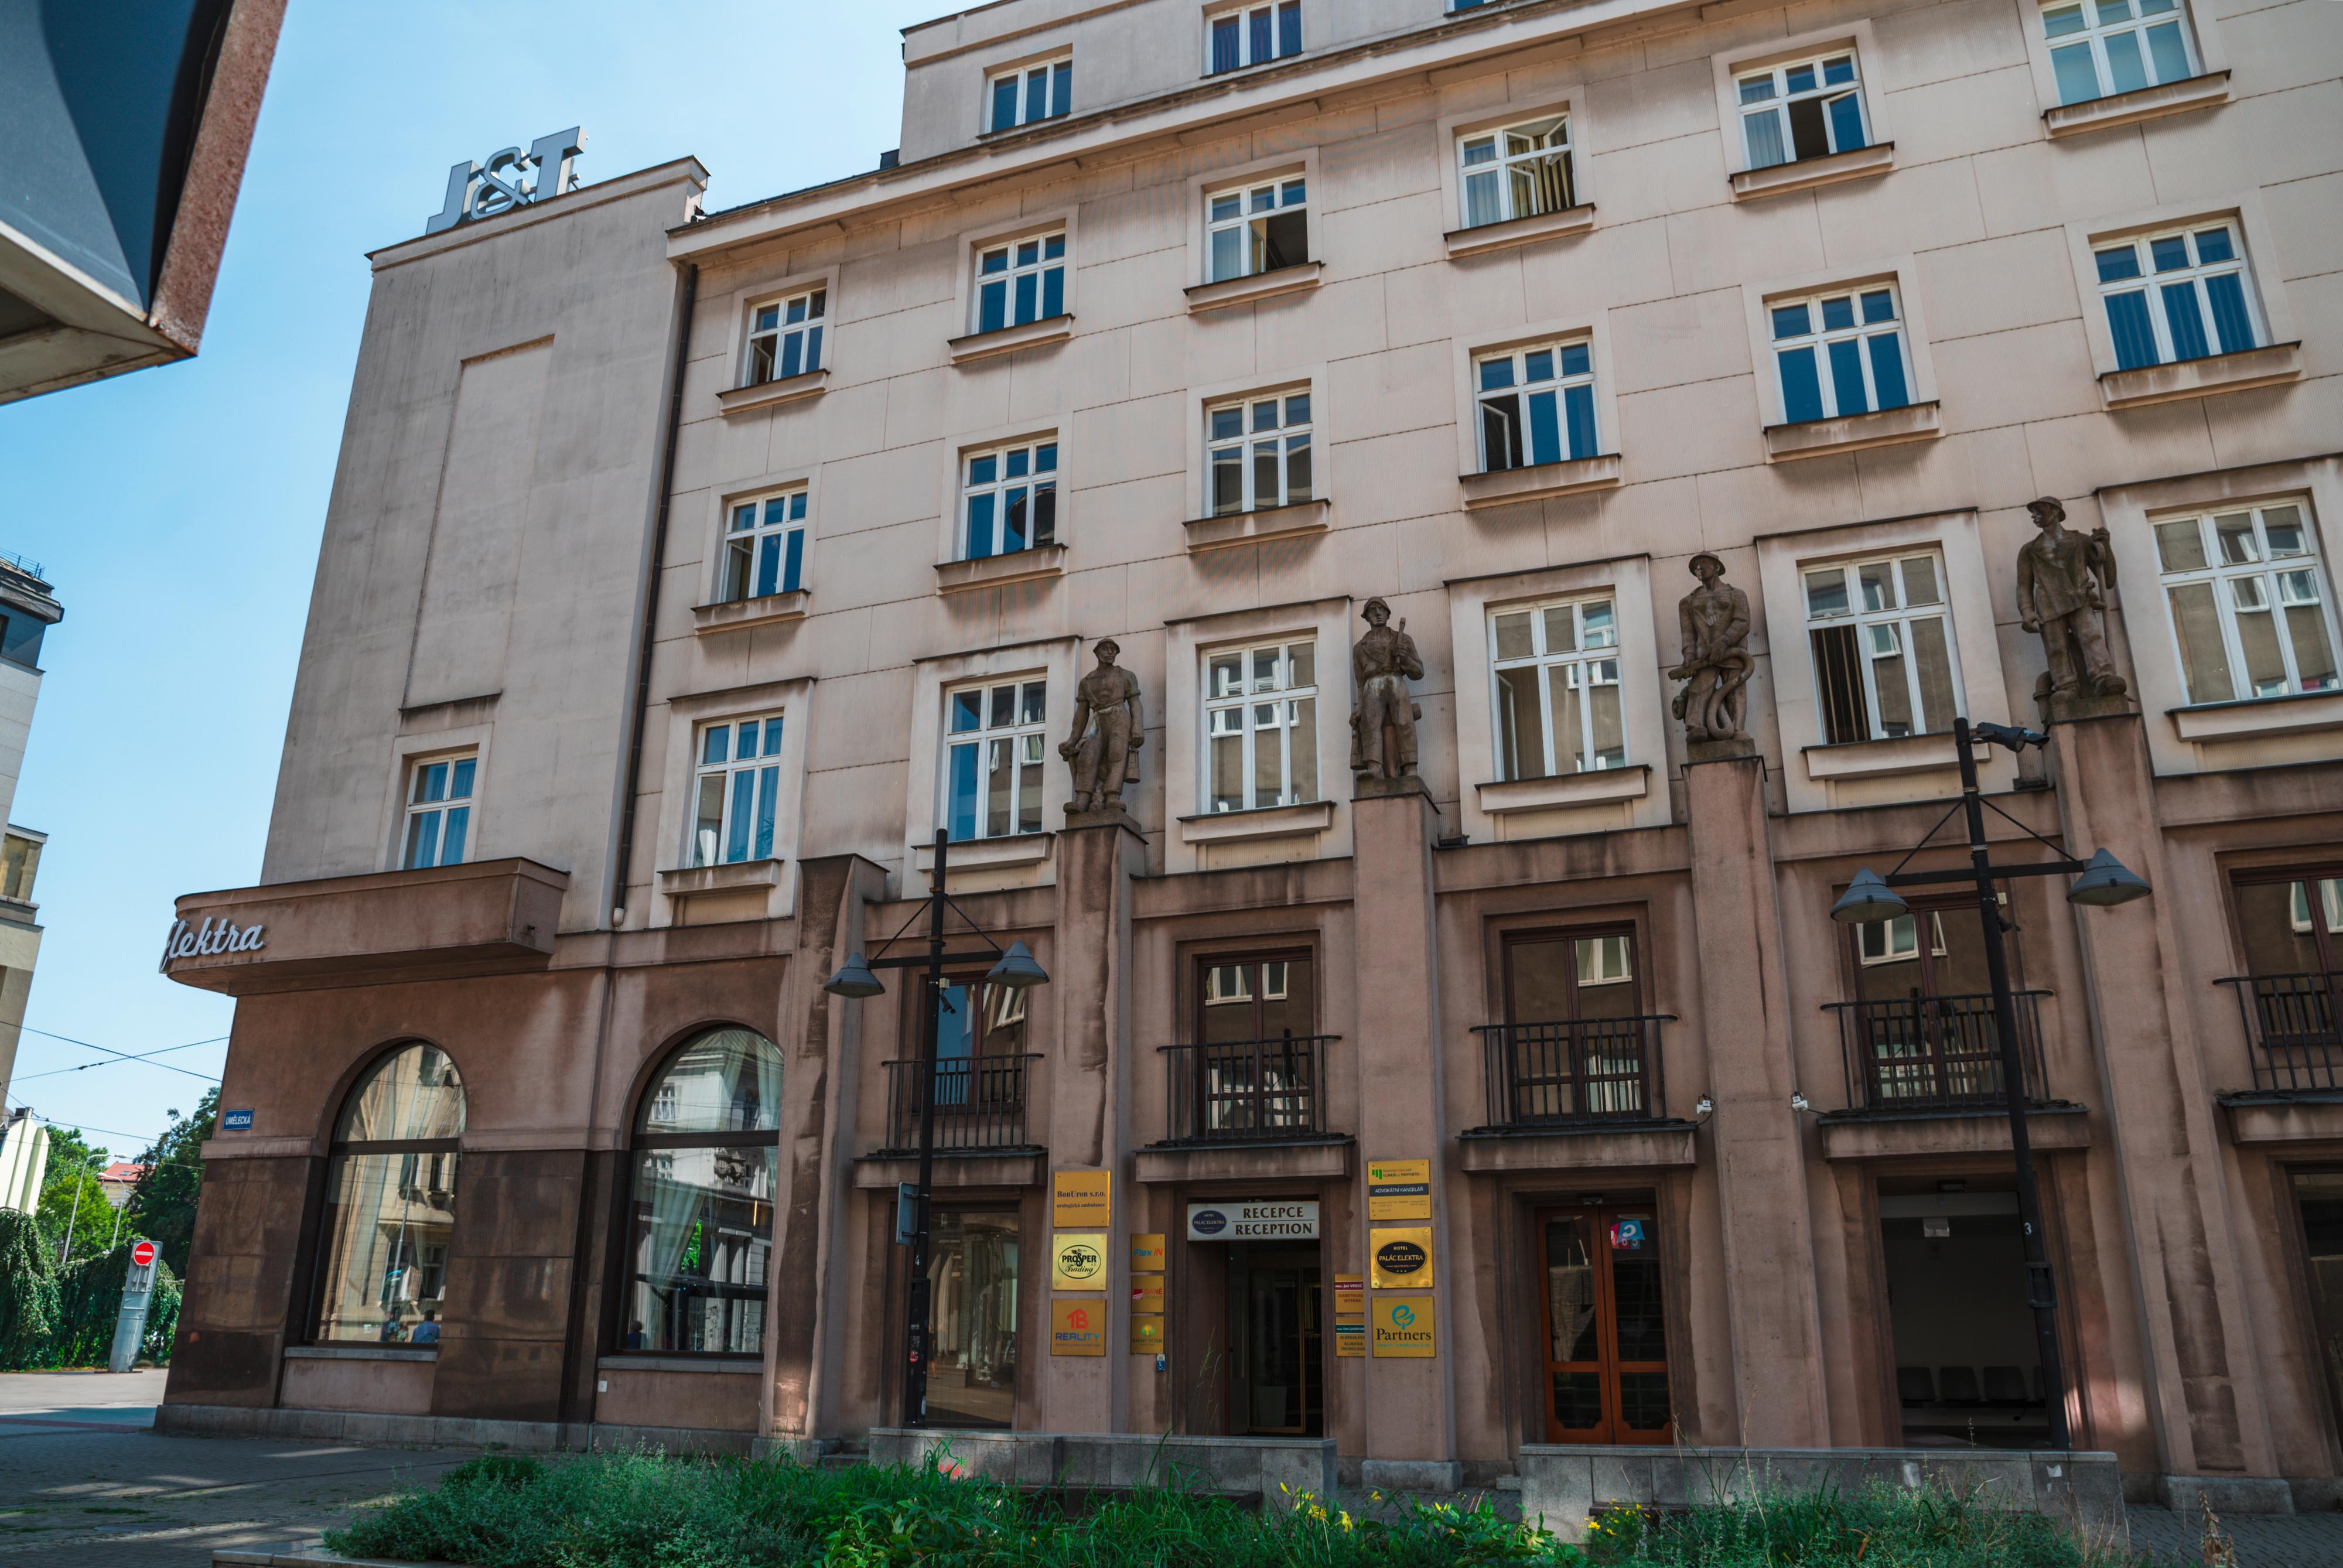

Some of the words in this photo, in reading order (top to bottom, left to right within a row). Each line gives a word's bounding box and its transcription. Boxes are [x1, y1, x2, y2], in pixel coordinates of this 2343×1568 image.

[426, 126, 583, 235] J&T
[226, 1114, 251, 1125] UMĚLECKÁ
[1243, 1207, 1303, 1218] RECEPCE
[1235, 1224, 1312, 1235] RECEPTION
[2024, 1222, 2031, 1235] 3
[915, 1255, 920, 1265] 4
[1062, 1253, 1097, 1266] PROSPER
[1065, 1264, 1093, 1275] Trading
[1376, 1328, 1431, 1340] Partners
